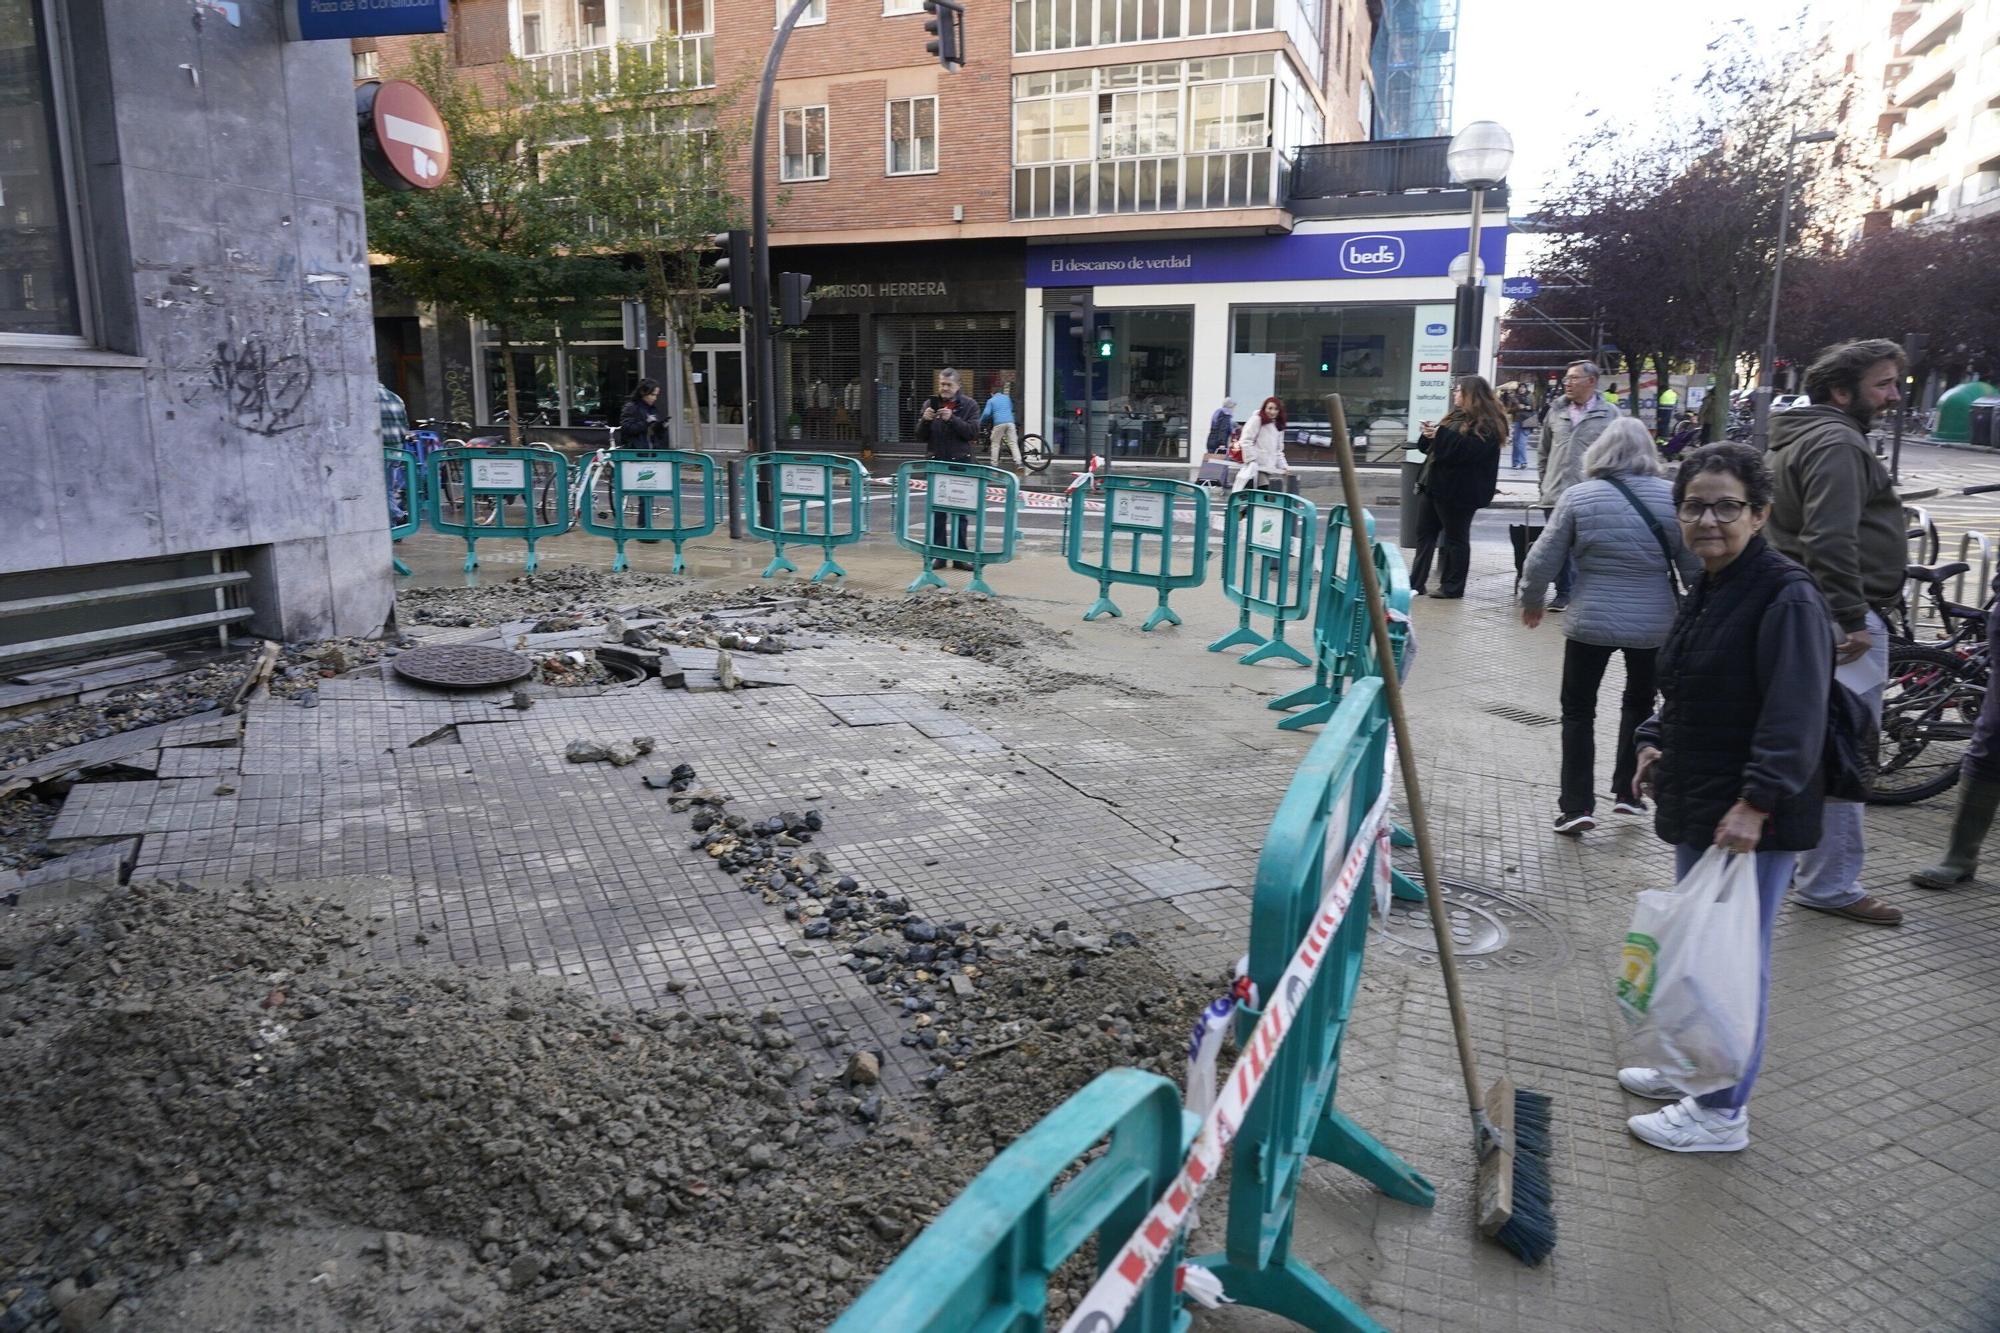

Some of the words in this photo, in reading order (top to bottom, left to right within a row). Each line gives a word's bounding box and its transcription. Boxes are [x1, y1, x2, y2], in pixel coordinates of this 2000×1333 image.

[341, 0, 355, 11] de
[1051, 259, 1063, 272] El
[1066, 259, 1124, 271] descanso
[1128, 256, 1143, 269] de
[1146, 255, 1191, 268] verdad
[880, 282, 947, 296] HERRERA
